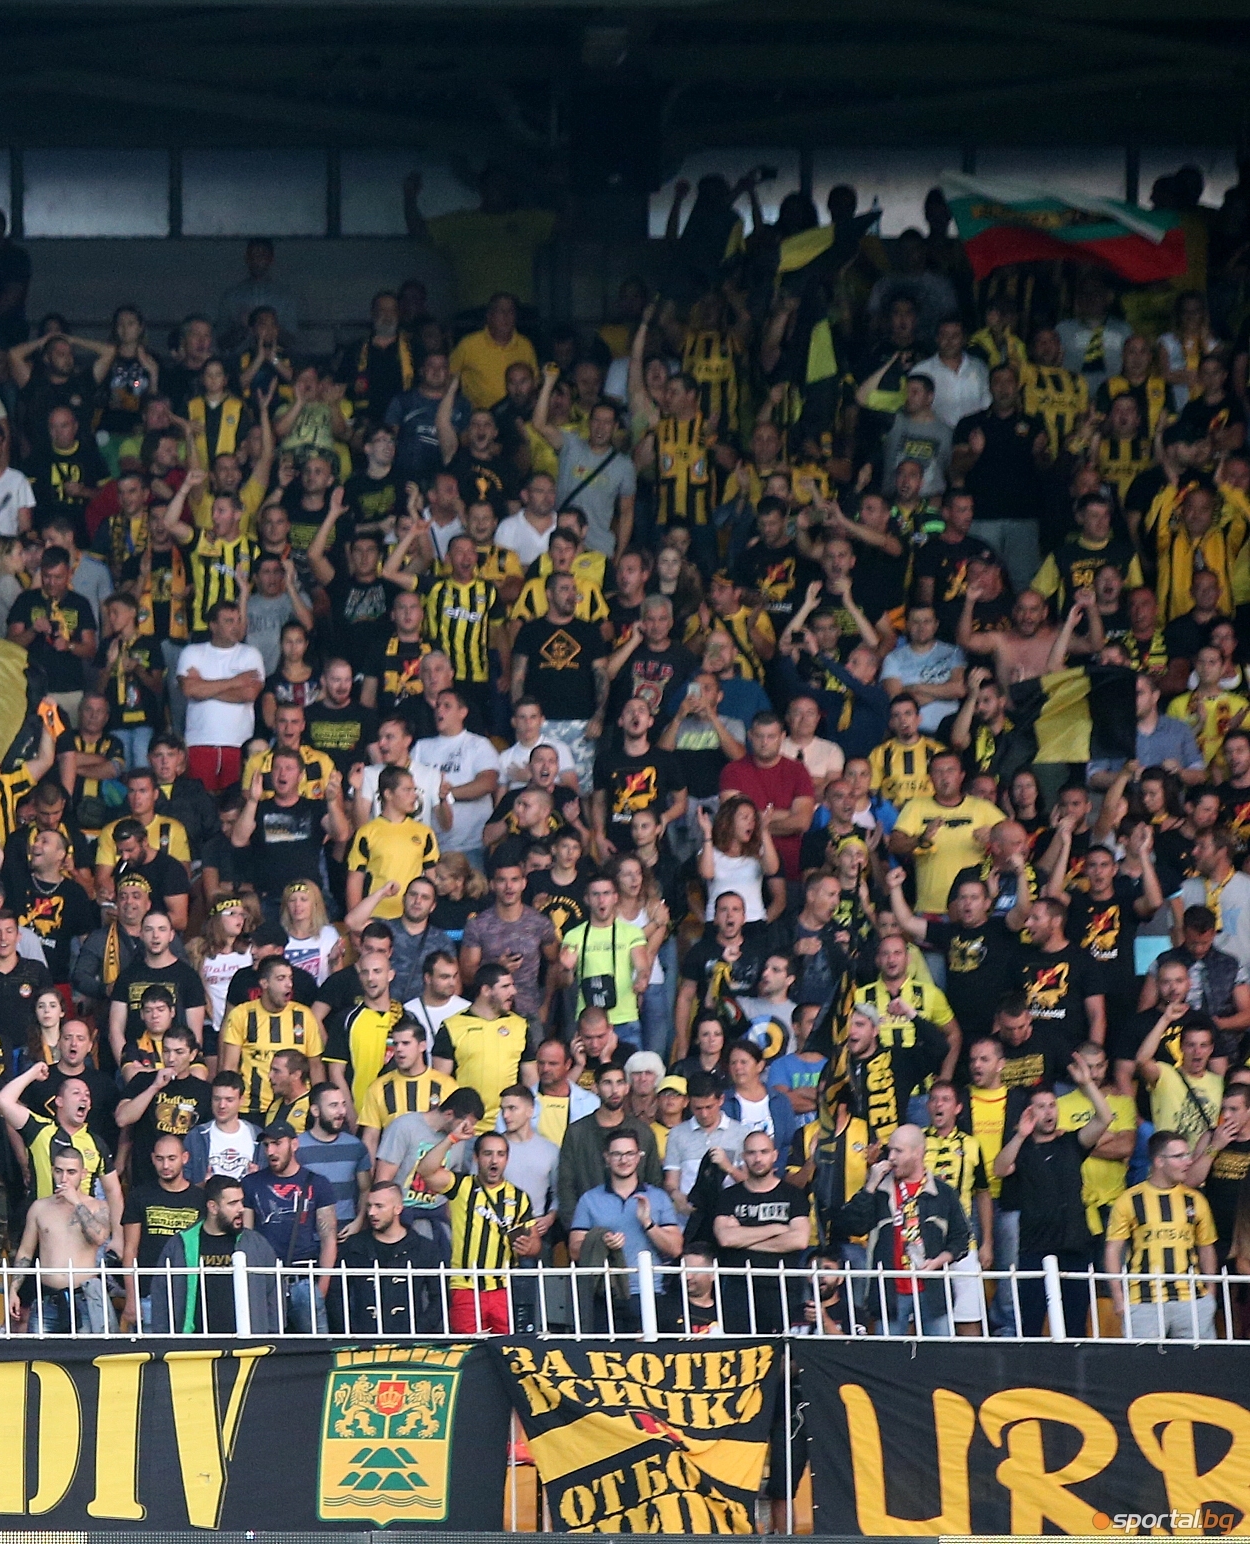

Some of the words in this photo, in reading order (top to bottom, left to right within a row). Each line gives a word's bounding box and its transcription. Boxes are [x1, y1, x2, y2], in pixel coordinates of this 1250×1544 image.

[502, 1345, 578, 1378] ЗА
[586, 1344, 775, 1391] БОТЕВ
[517, 1373, 764, 1430] ВСИЧКО
[558, 1469, 627, 1528] ОТ
